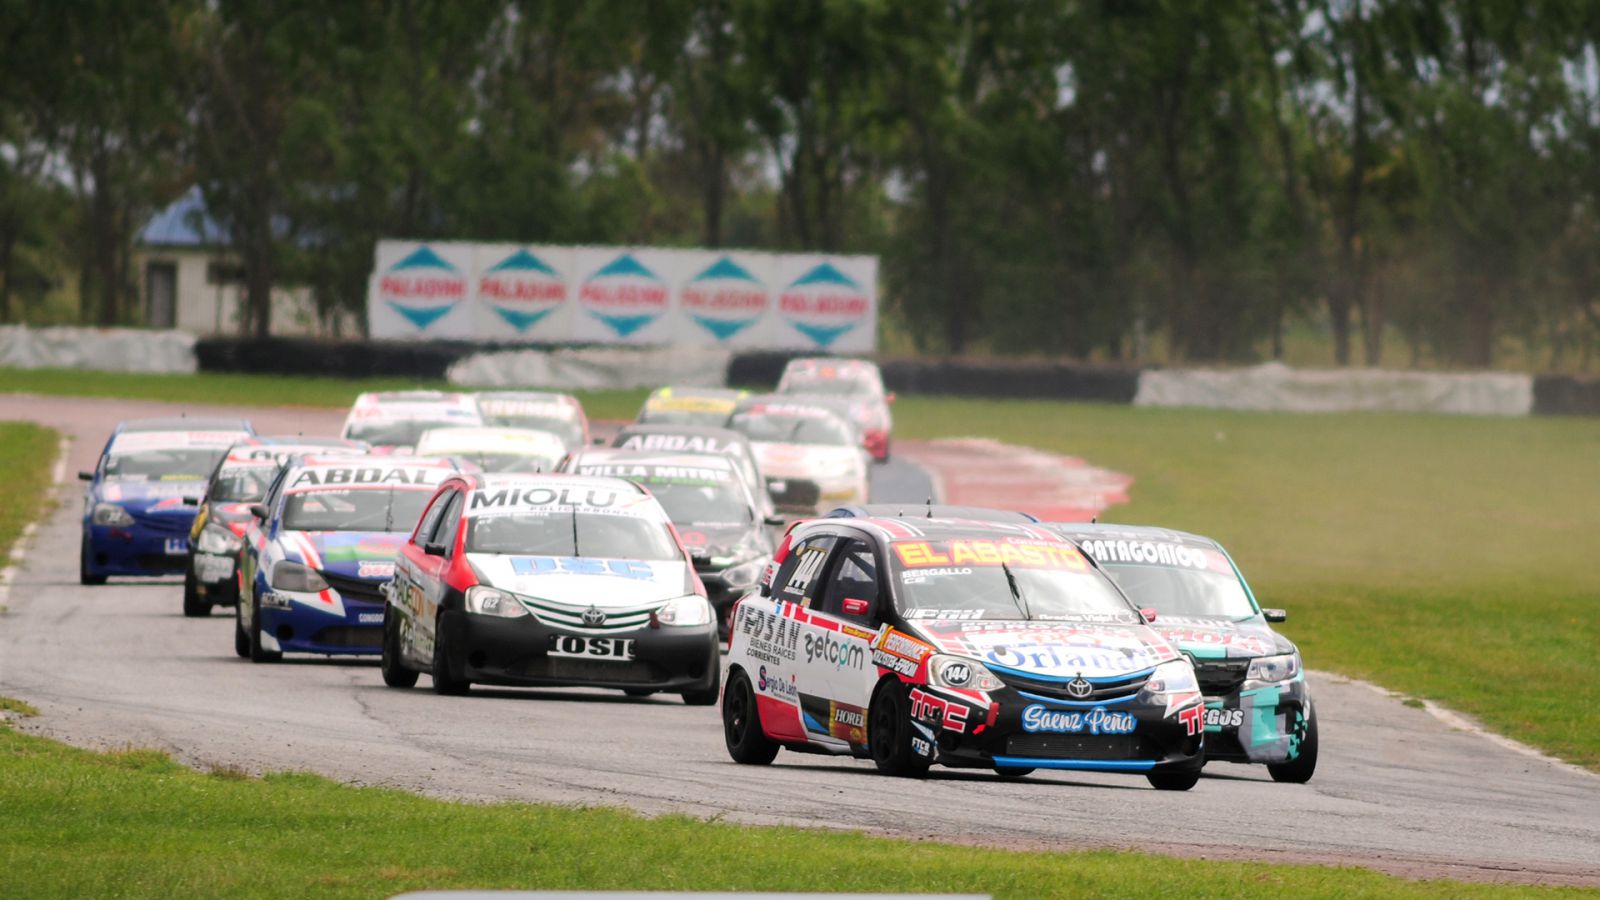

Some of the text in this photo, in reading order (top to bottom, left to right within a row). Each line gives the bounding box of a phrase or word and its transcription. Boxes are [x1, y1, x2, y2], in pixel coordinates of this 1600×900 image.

[579, 465, 648, 477] VILLA
[470, 487, 617, 510] MIOLU
[896, 543, 948, 566] EL
[953, 541, 1087, 571] ABASTO
[787, 548, 826, 591] 144
[902, 567, 972, 579] BERGALLO
[746, 647, 781, 666] CORRIENTES
[749, 637, 797, 661] BIENES RAICES
[947, 666, 970, 681] 144
[1022, 705, 1135, 734] Saenz Peña
